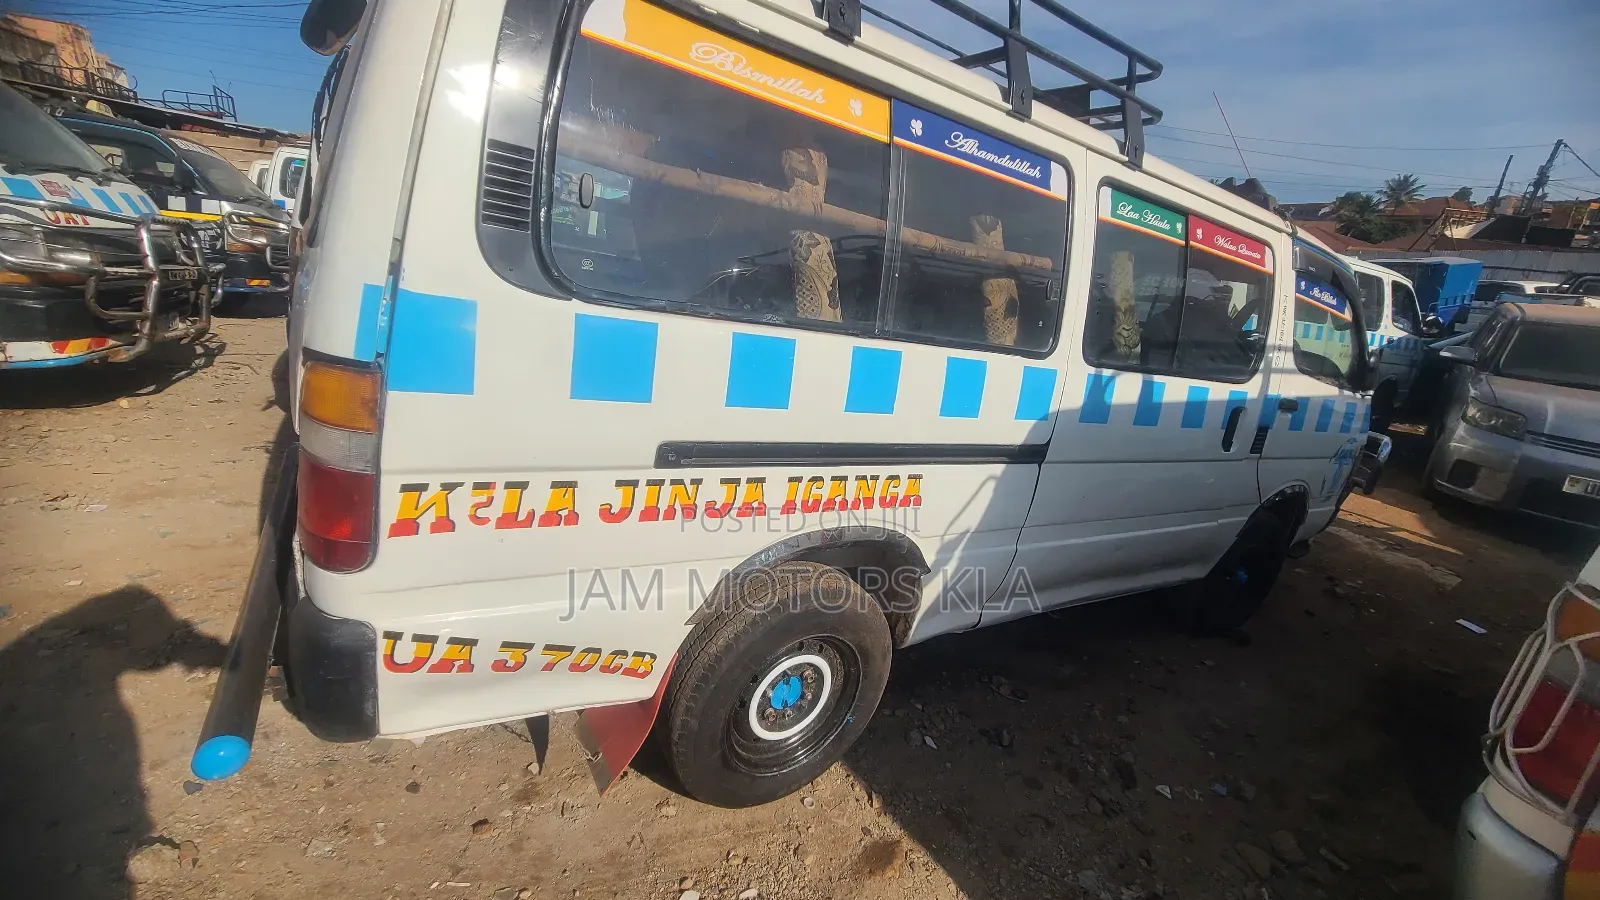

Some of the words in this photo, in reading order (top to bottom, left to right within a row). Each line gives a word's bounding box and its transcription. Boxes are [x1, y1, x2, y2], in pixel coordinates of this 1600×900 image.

[689, 42, 826, 103] Bismillah
[944, 131, 1041, 178] Alhamdulillah
[1116, 201, 1140, 220] Laa
[599, 477, 767, 524] JINJA
[780, 474, 924, 515] IGANGA
